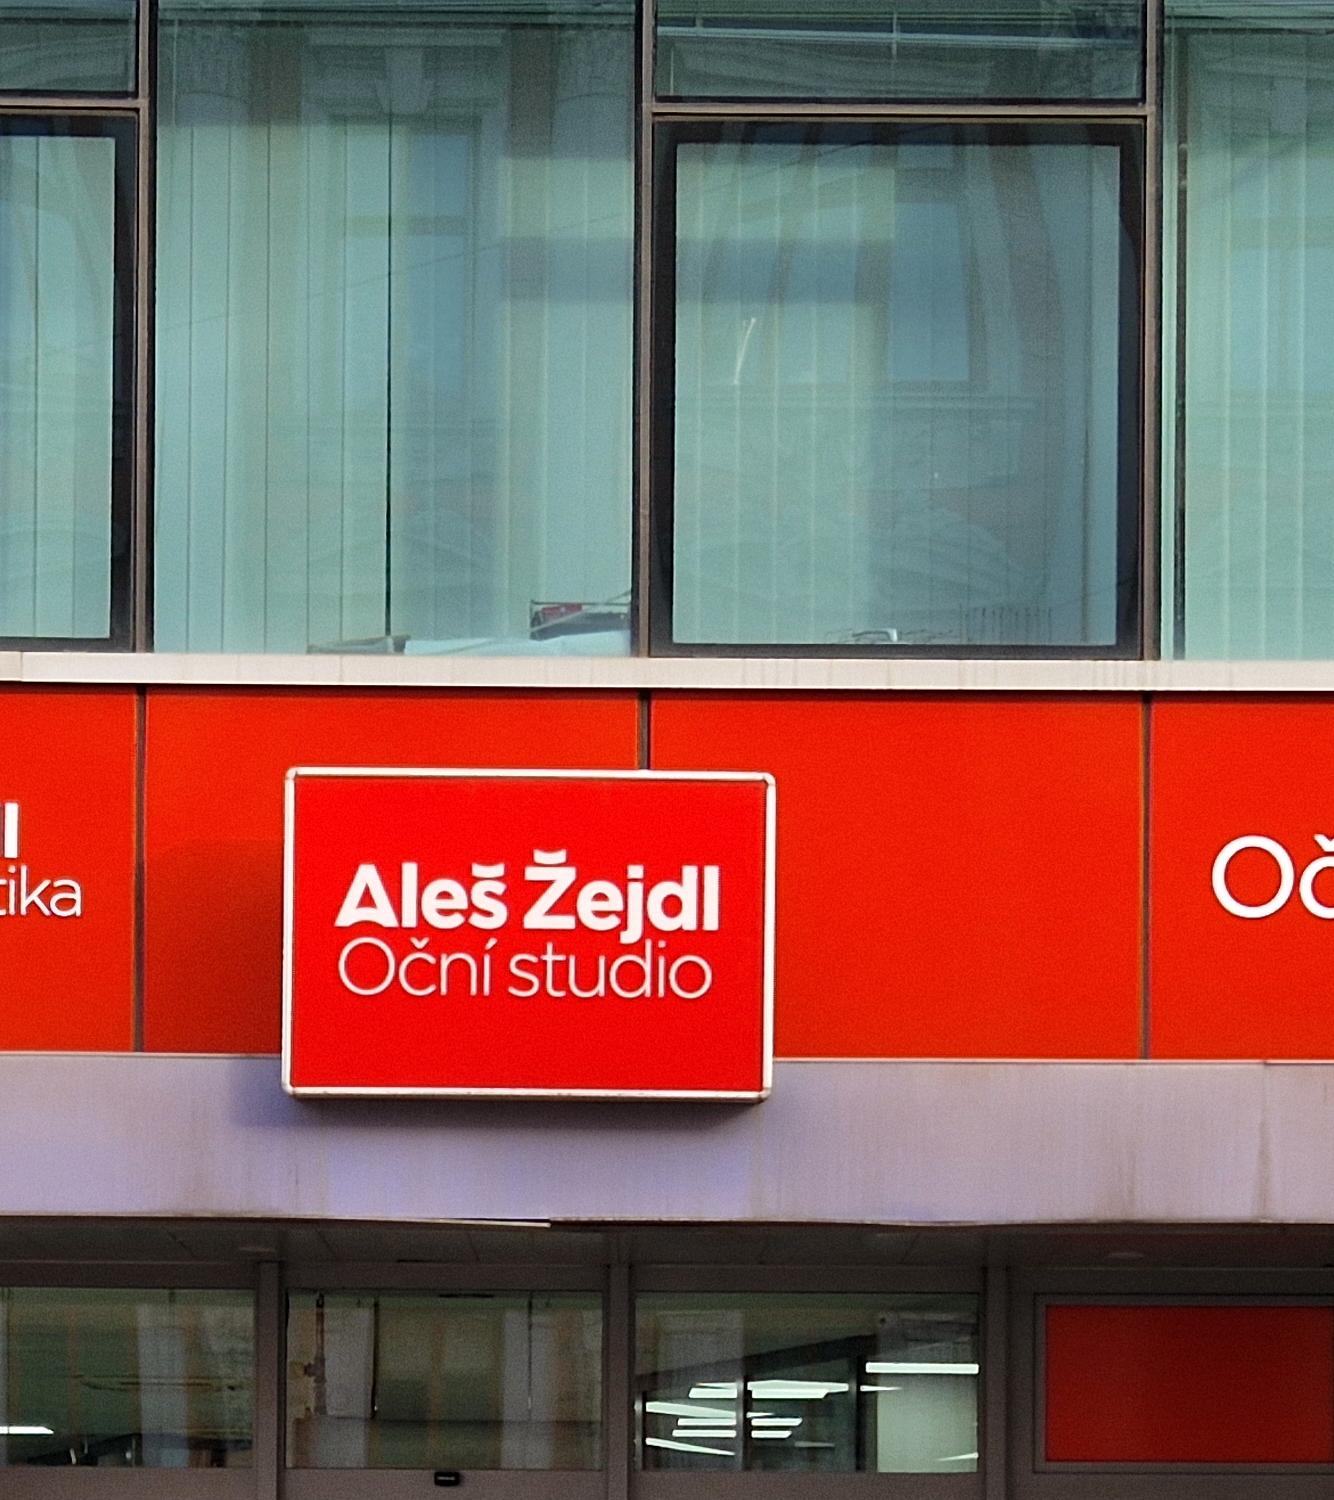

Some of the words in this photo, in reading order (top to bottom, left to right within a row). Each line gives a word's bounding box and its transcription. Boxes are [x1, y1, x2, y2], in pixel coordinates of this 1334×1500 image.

[334, 862, 508, 930] Aleš
[523, 849, 720, 944] Žejdl
[338, 936, 498, 997] Oční
[507, 939, 713, 999] studio
